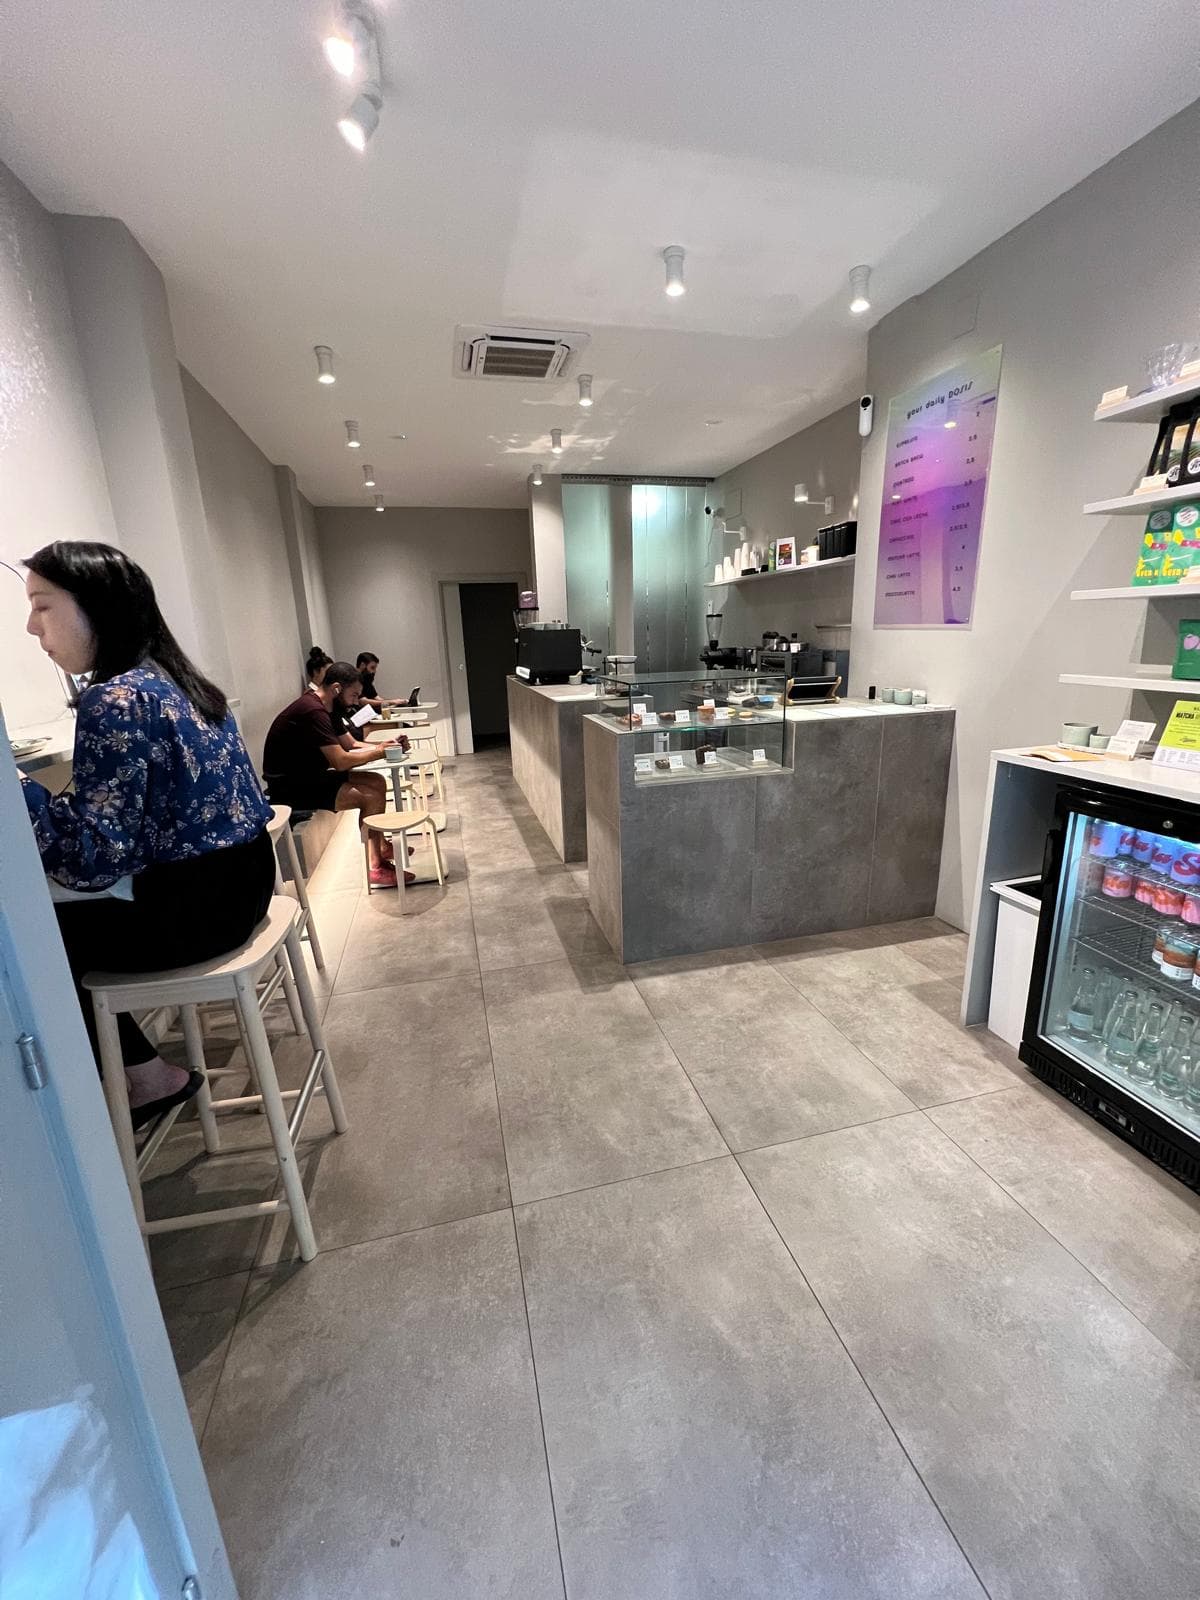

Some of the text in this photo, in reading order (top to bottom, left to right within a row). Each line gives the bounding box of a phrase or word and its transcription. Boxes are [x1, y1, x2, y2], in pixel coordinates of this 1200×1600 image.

[906, 381, 974, 420] your daily DOSIS
